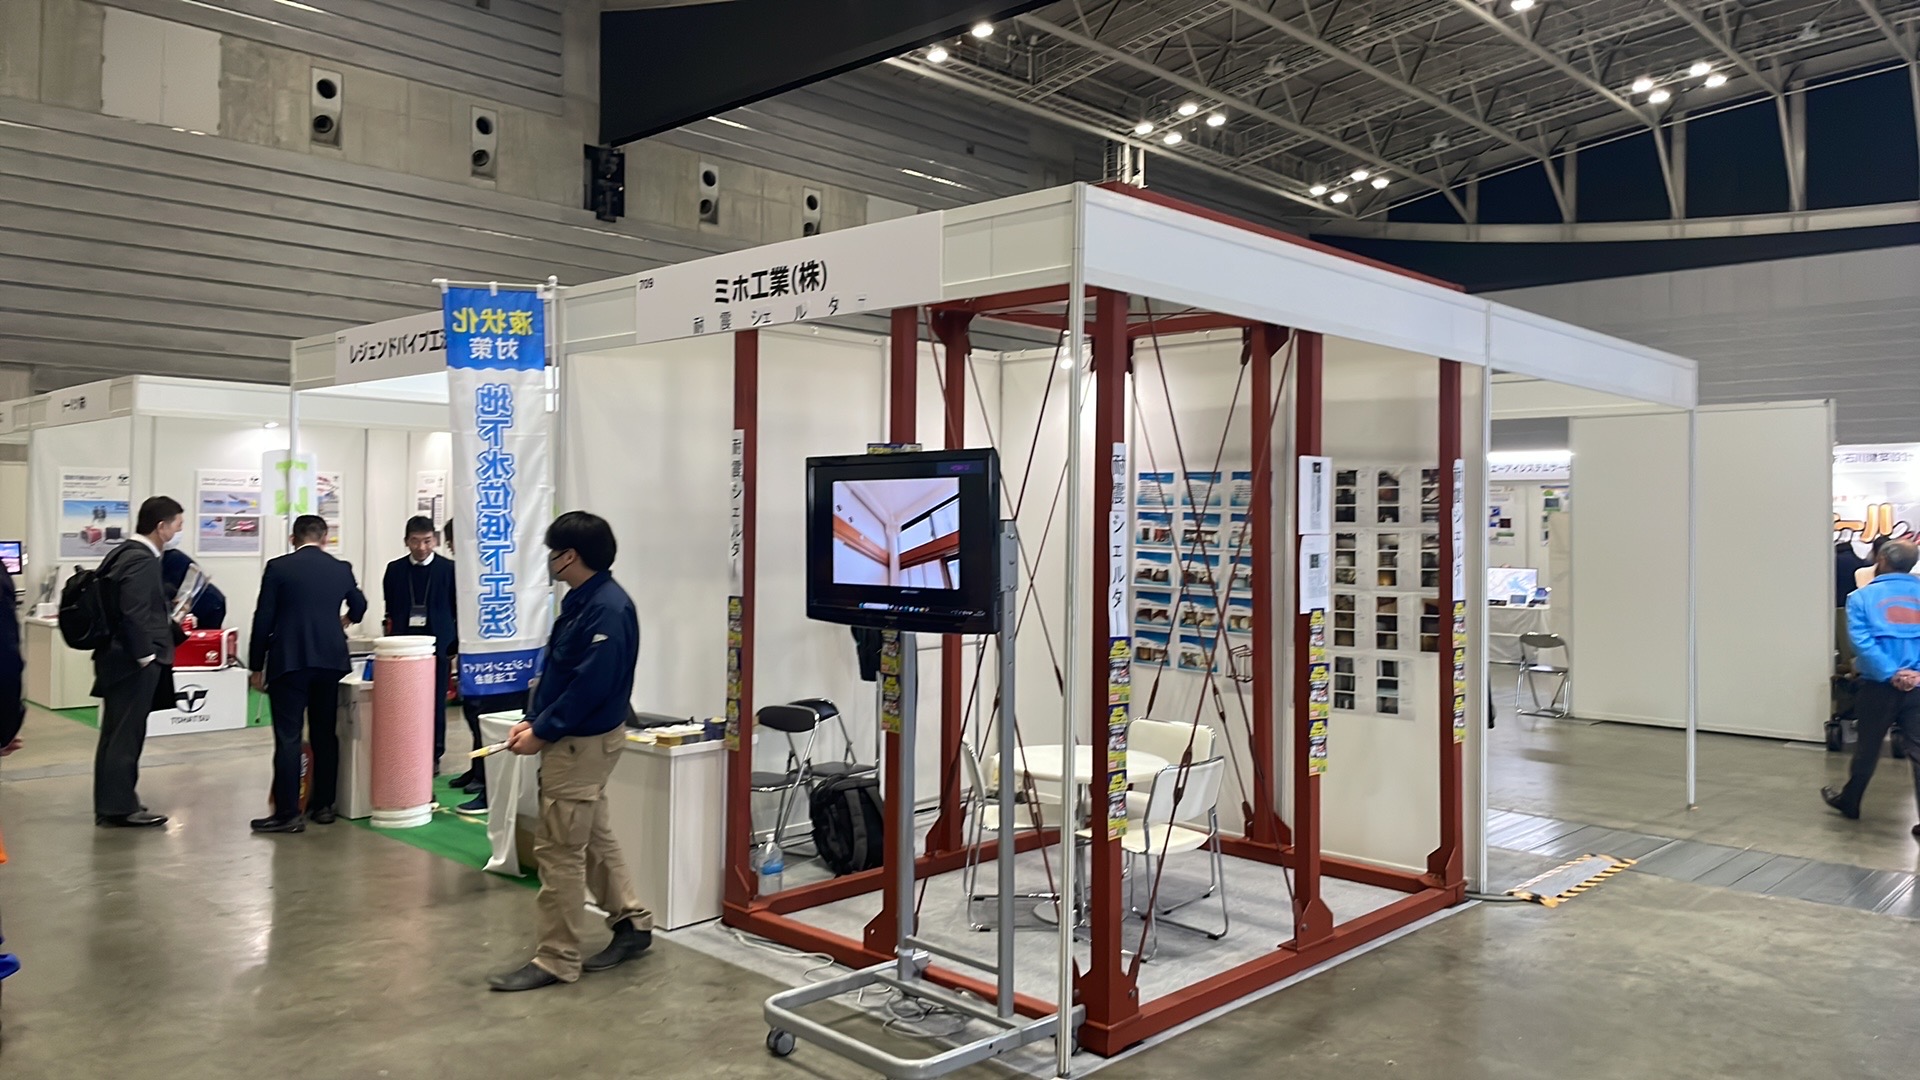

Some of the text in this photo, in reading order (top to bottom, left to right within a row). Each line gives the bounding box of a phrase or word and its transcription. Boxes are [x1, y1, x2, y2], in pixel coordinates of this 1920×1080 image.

[639, 277, 655, 291] 709
[714, 259, 828, 304] ミホ工業(株)
